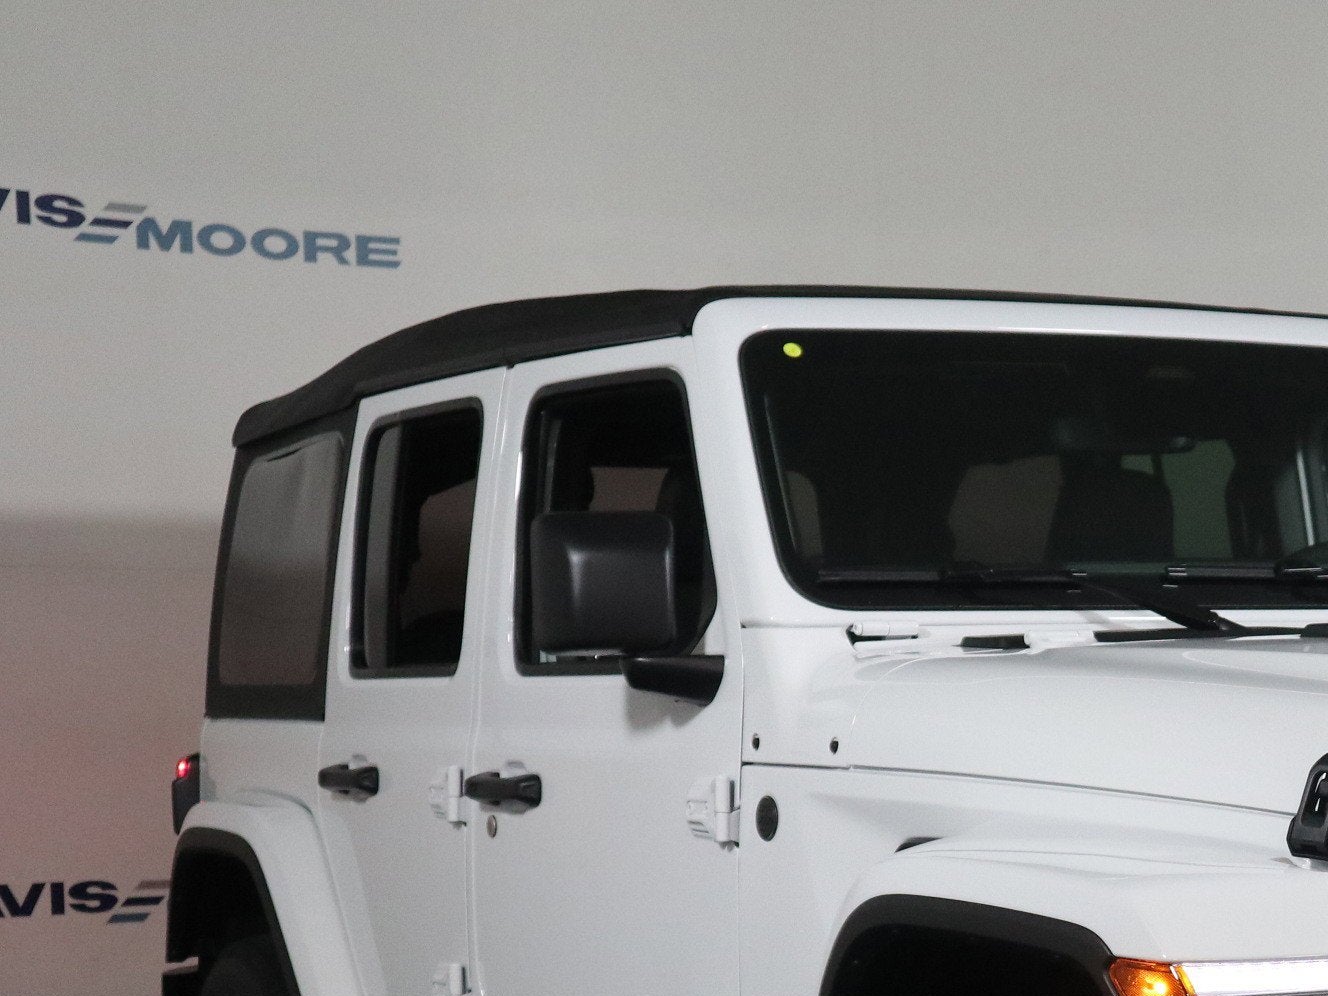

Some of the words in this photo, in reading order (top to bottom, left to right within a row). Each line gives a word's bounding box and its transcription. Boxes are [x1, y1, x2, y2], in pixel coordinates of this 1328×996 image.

[0, 188, 86, 229] IS
[135, 216, 402, 269] MOORE
[0, 880, 119, 918] VIS
